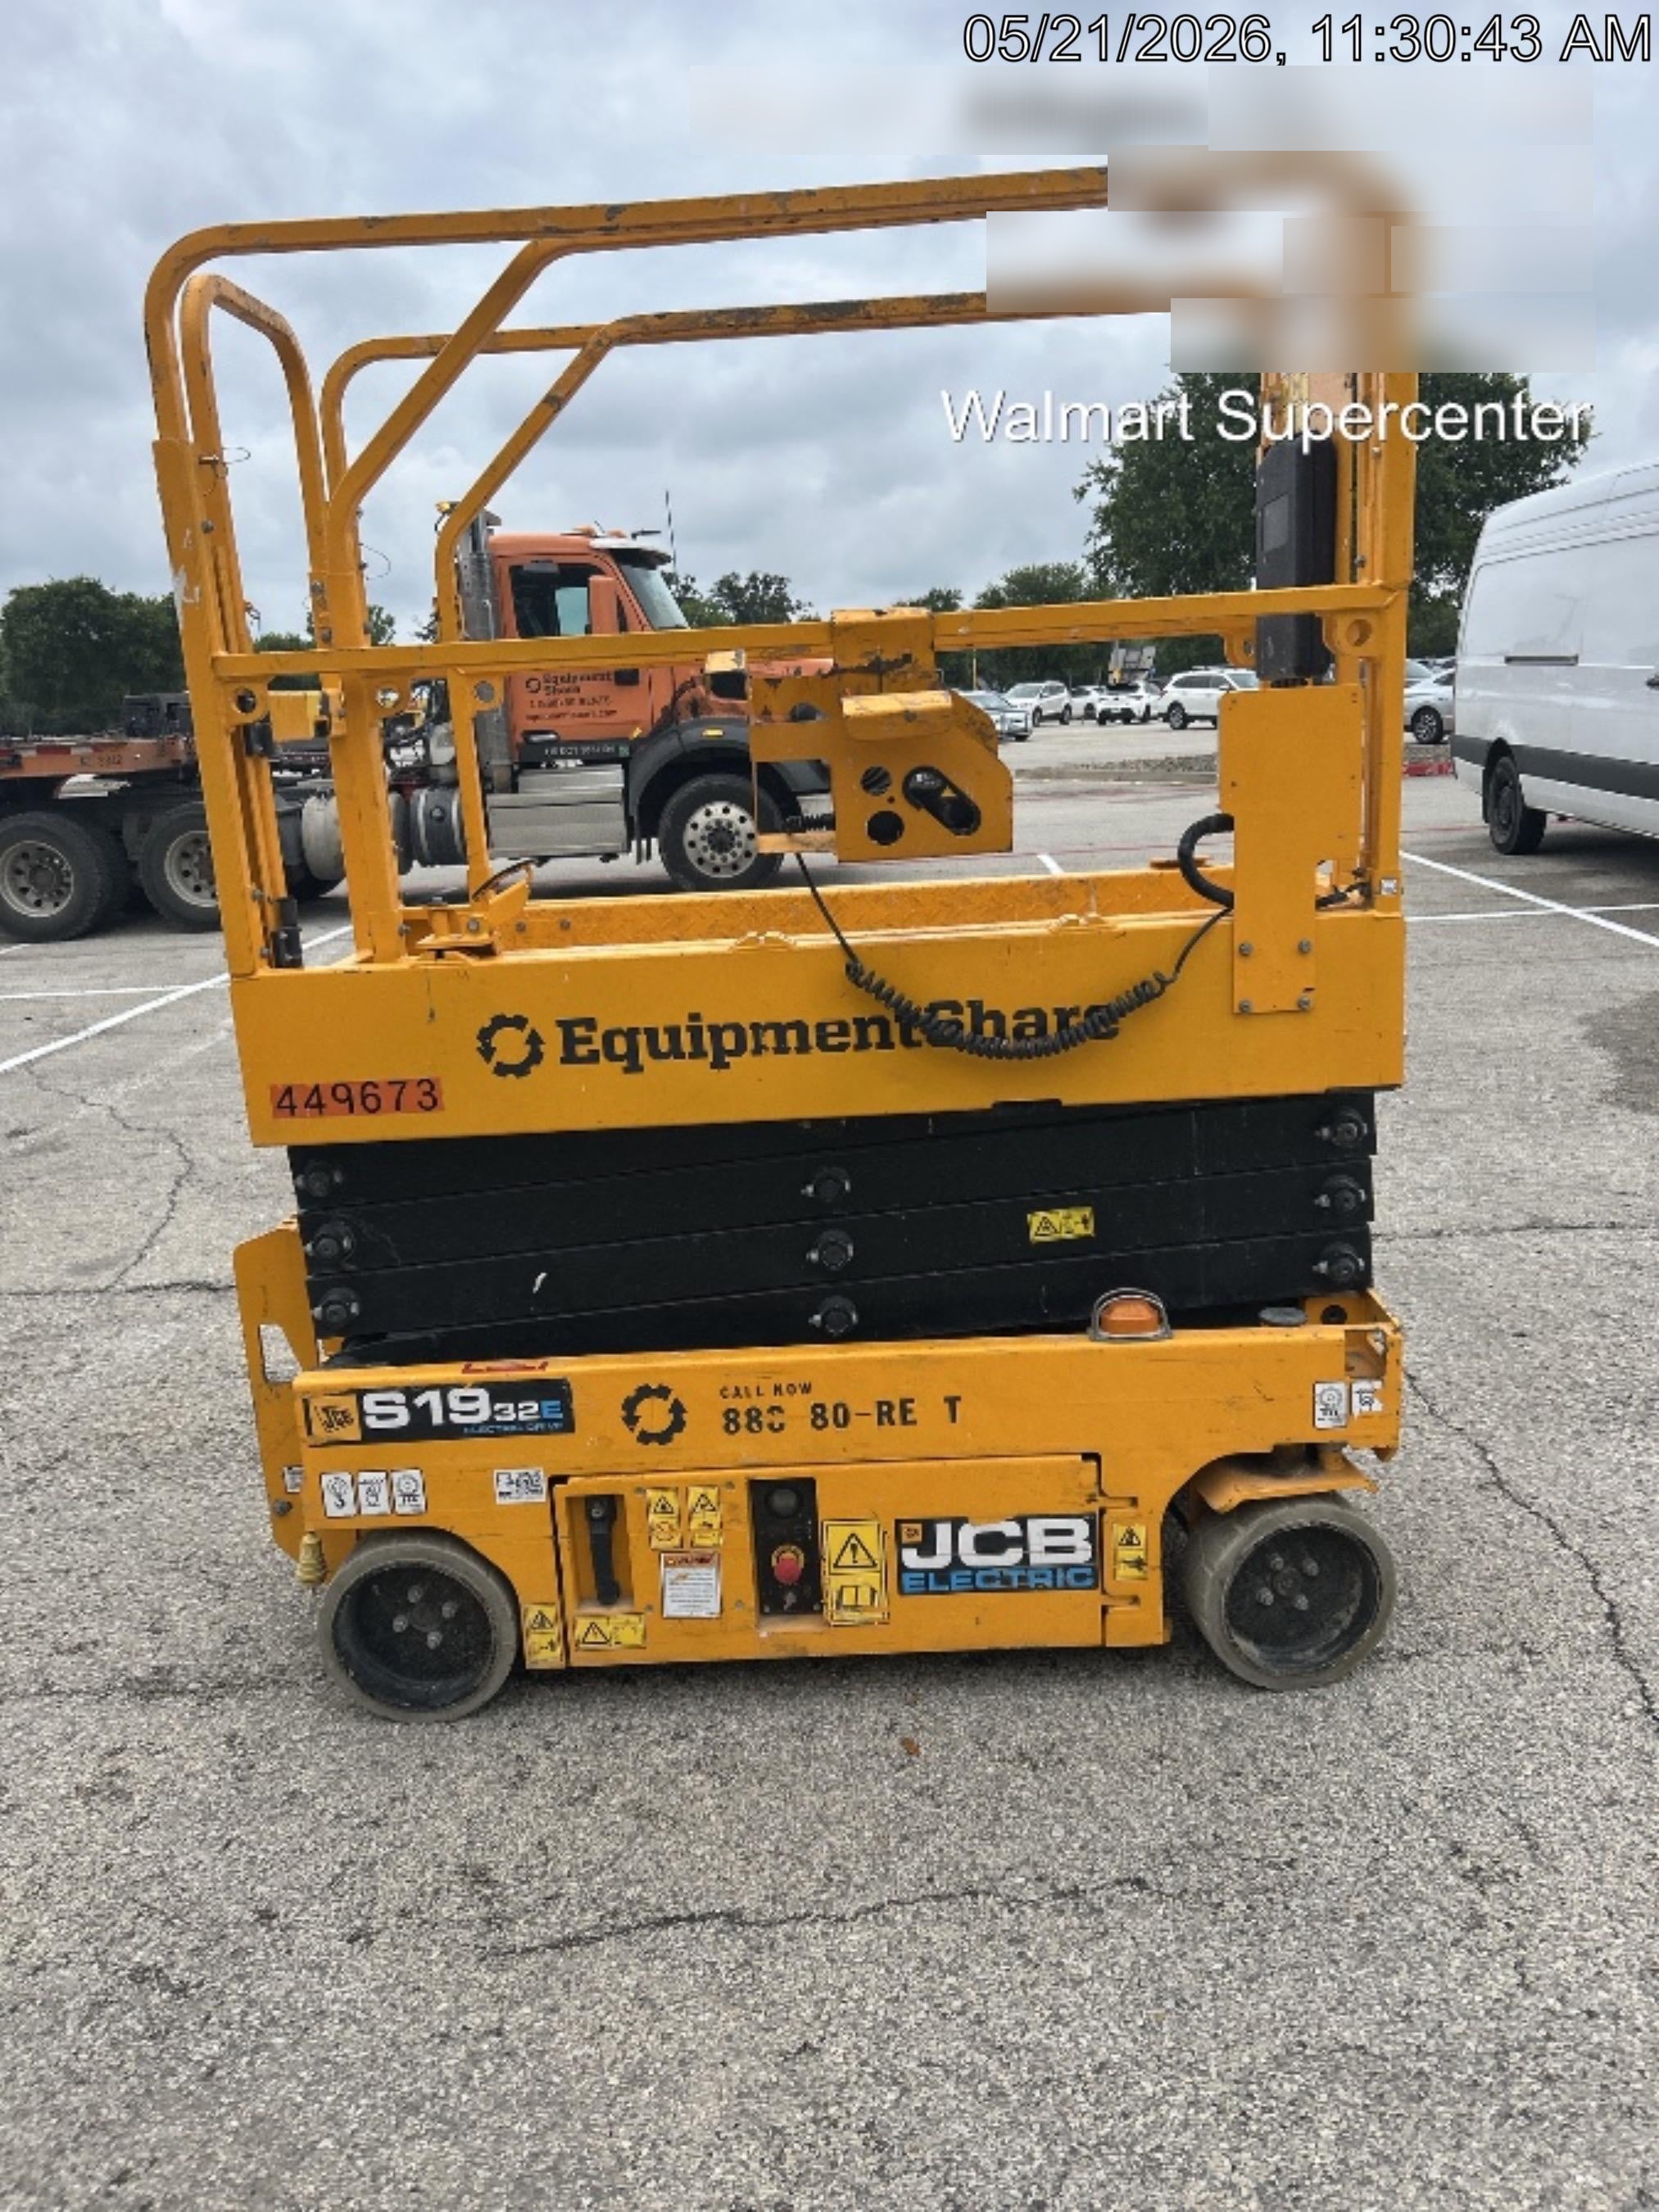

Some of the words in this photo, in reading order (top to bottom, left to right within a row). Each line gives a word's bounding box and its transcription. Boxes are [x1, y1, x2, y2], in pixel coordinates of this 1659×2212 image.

[275, 1078, 439, 1117] 449673
[719, 1385, 764, 1399] CALL
[773, 1381, 813, 1397] NOW
[902, 1518, 1092, 1570] JCB
[902, 1566, 1095, 1594] ELECTRIC
